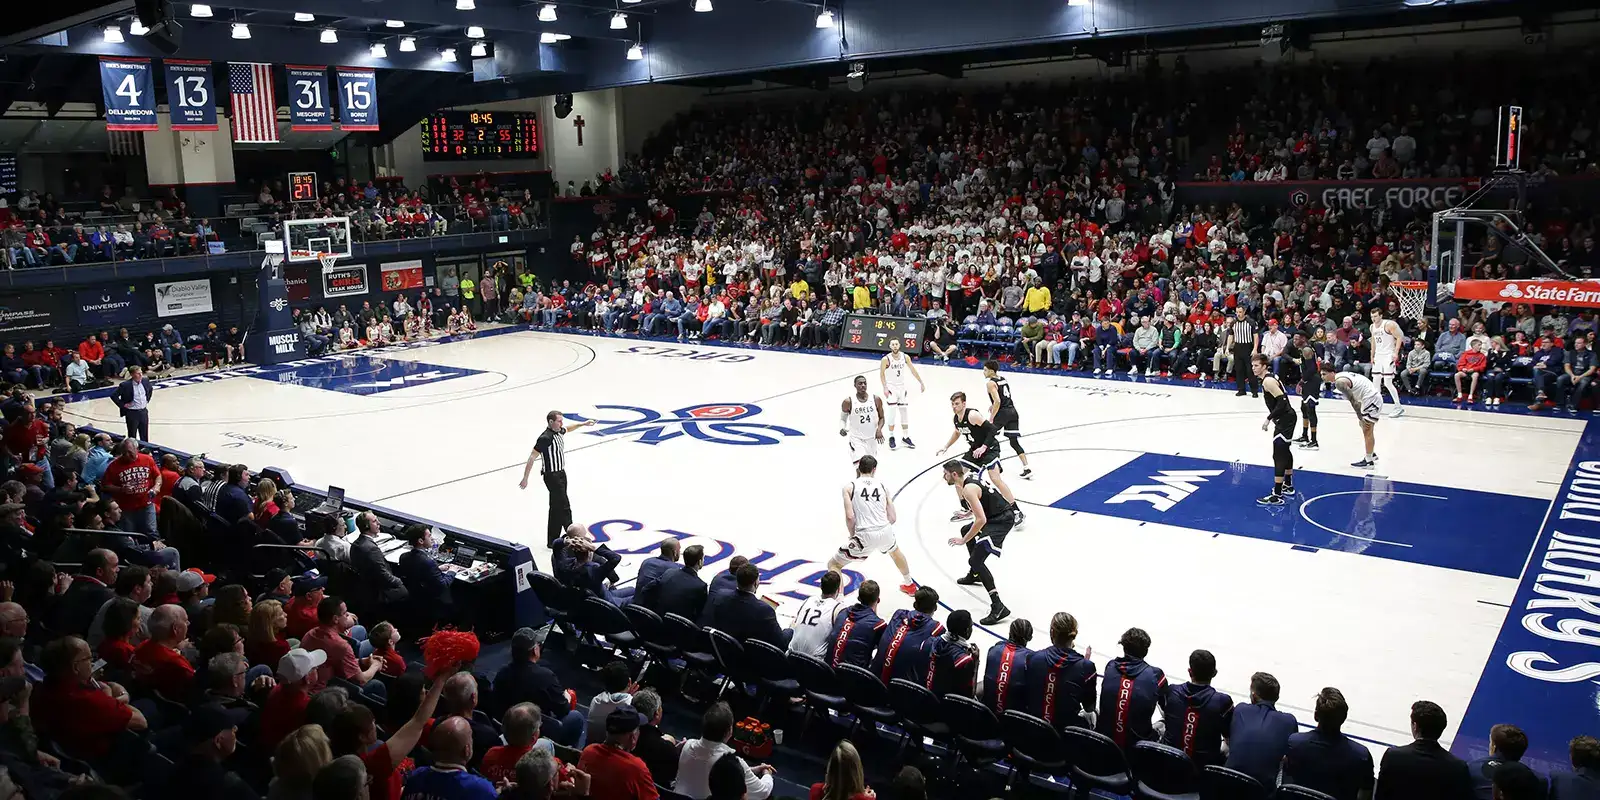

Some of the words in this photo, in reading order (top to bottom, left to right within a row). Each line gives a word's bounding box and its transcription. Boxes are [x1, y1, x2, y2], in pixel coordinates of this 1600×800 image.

[116, 74, 142, 106] 4
[174, 76, 208, 107] 13
[295, 80, 323, 108] 31
[344, 81, 370, 109] 15
[470, 113, 492, 124] 18:45
[453, 130, 464, 140] 32
[478, 130, 484, 140] 2
[500, 130, 511, 140] 55
[294, 184, 312, 199] 27
[1322, 187, 1376, 210] GAEL
[1385, 186, 1462, 209] FORCE
[82, 302, 130, 312] UNIVERSITY
[874, 320, 896, 330] 18:45
[268, 333, 300, 346] MUSCLE
[851, 334, 862, 344] 32
[878, 338, 884, 346] 2
[905, 339, 916, 348] 55
[275, 343, 296, 354] MILK
[1002, 384, 1011, 398] 4
[854, 406, 874, 414] GAELS
[860, 414, 871, 424] 24
[118, 466, 150, 477] SWEET
[860, 488, 880, 502] 44
[800, 608, 822, 626] 12
[832, 624, 850, 668] GAELS
[884, 626, 908, 668] GAELS
[996, 662, 1010, 714] GAELS
[1116, 679, 1132, 732] GAELS
